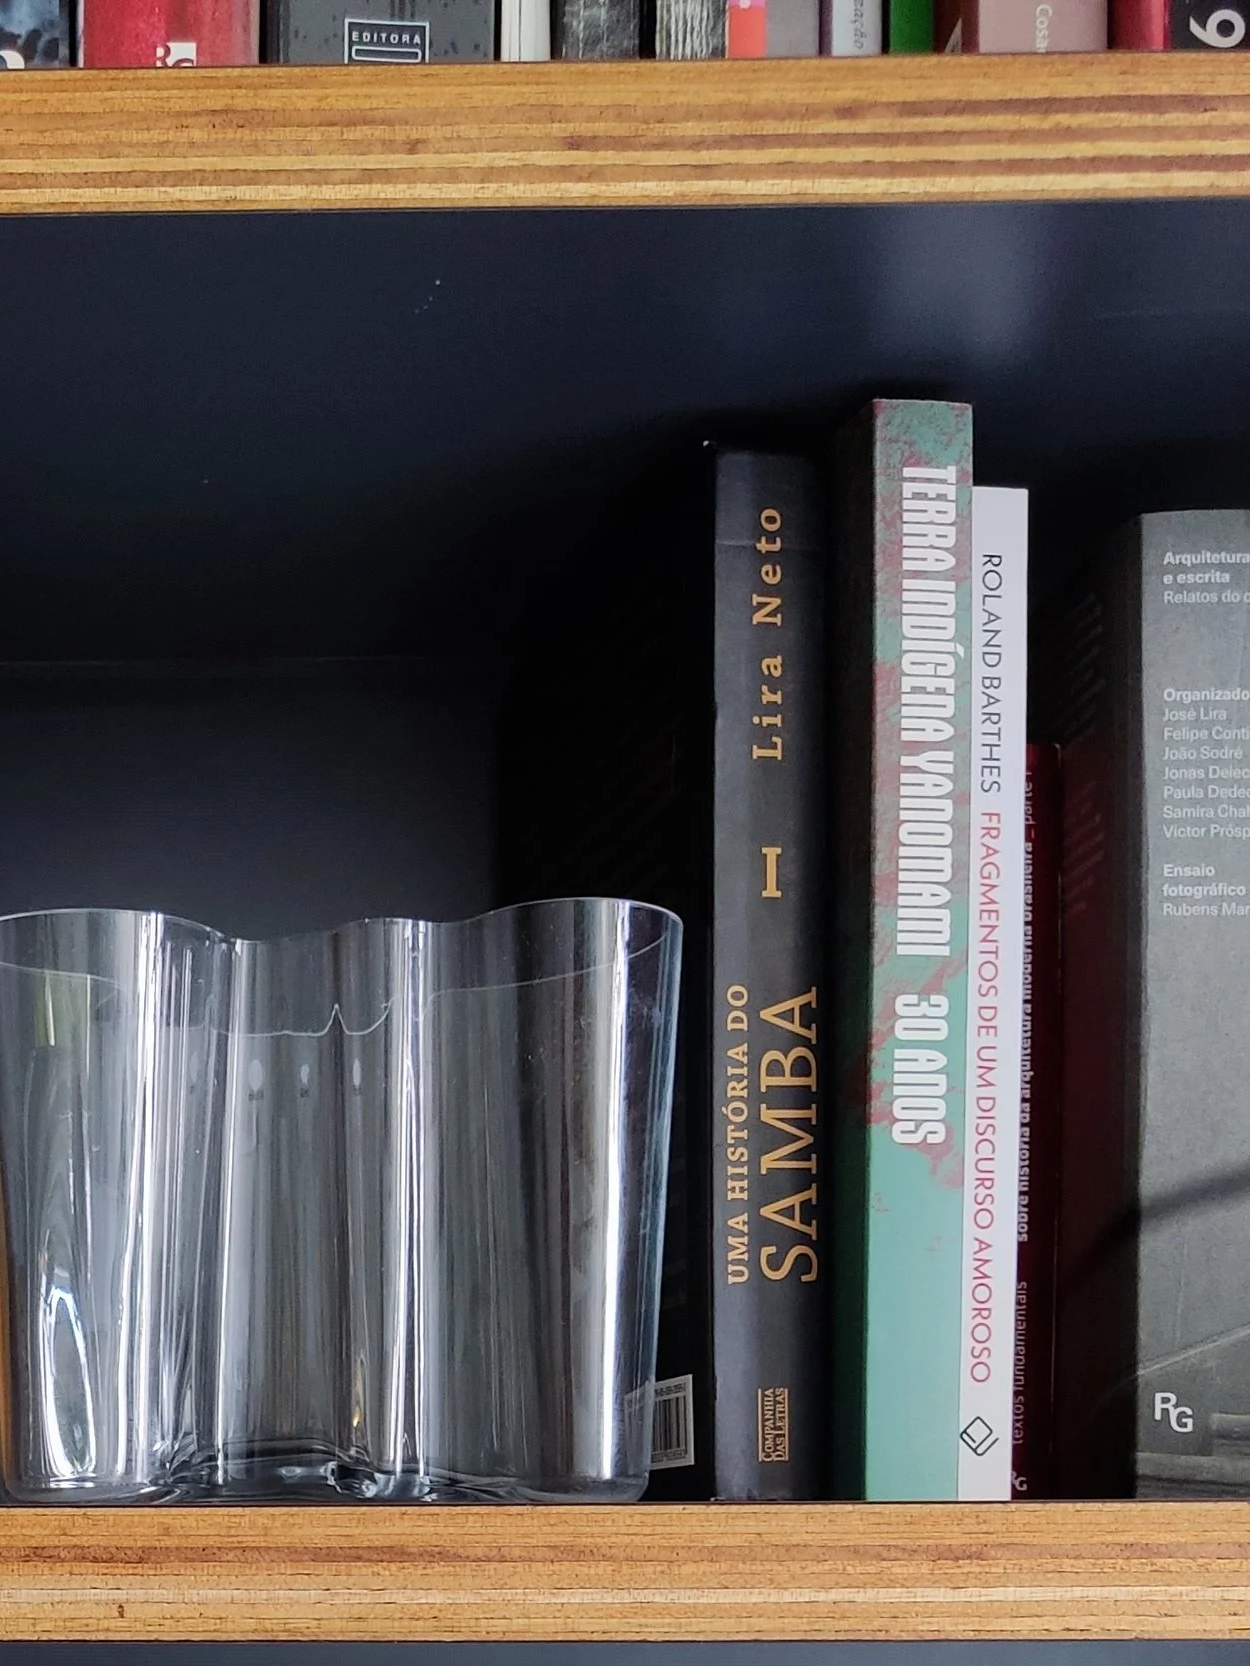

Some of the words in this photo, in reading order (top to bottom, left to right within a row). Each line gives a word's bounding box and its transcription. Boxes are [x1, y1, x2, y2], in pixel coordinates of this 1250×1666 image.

[352, 31, 421, 45] EDITORA
[901, 465, 956, 572] TERRA
[752, 507, 783, 627] Neto
[1163, 549, 1250, 567] Arquitetura
[1163, 574, 1173, 584] e
[1177, 568, 1230, 584] escrita
[981, 554, 1003, 669] ROLAND
[1163, 590, 1218, 605] Relatos
[1221, 589, 1241, 603] do
[900, 578, 964, 742] INDÍGENA
[752, 655, 783, 761] Lira
[1163, 687, 1250, 704] Organizado
[1163, 706, 1196, 721] José
[1200, 706, 1227, 720] Lira
[980, 675, 1003, 795] BARTHES
[1163, 726, 1209, 742] Felipe
[1163, 745, 1196, 760] João
[1200, 745, 1243, 760] Sodré
[1163, 766, 1205, 779] Jonas
[1163, 785, 1204, 799] Paula
[1163, 804, 1214, 818] Samira
[896, 750, 955, 957] YANOMAMI
[1163, 863, 1215, 877] Ensaio
[977, 811, 1002, 995] FRAGMENTOS
[1162, 882, 1246, 899] fotográfico
[1163, 902, 1219, 916] Rubens
[727, 983, 748, 1031] DO
[894, 994, 949, 1041] 30
[974, 1004, 998, 1036] DE
[973, 1046, 998, 1093] UM
[891, 1048, 948, 1145] ANOS
[721, 1042, 748, 1202] HISTÓRIA
[759, 986, 817, 1284] SAMBA
[971, 1096, 997, 1231] DISCURSO
[728, 1212, 748, 1285] UMA
[970, 1236, 994, 1384] AMOROSO
[762, 1388, 774, 1462] COMPANHIA
[773, 1387, 786, 1434] LETRAS
[1154, 1392, 1194, 1433] RG
[774, 1437, 786, 1461] DAS
